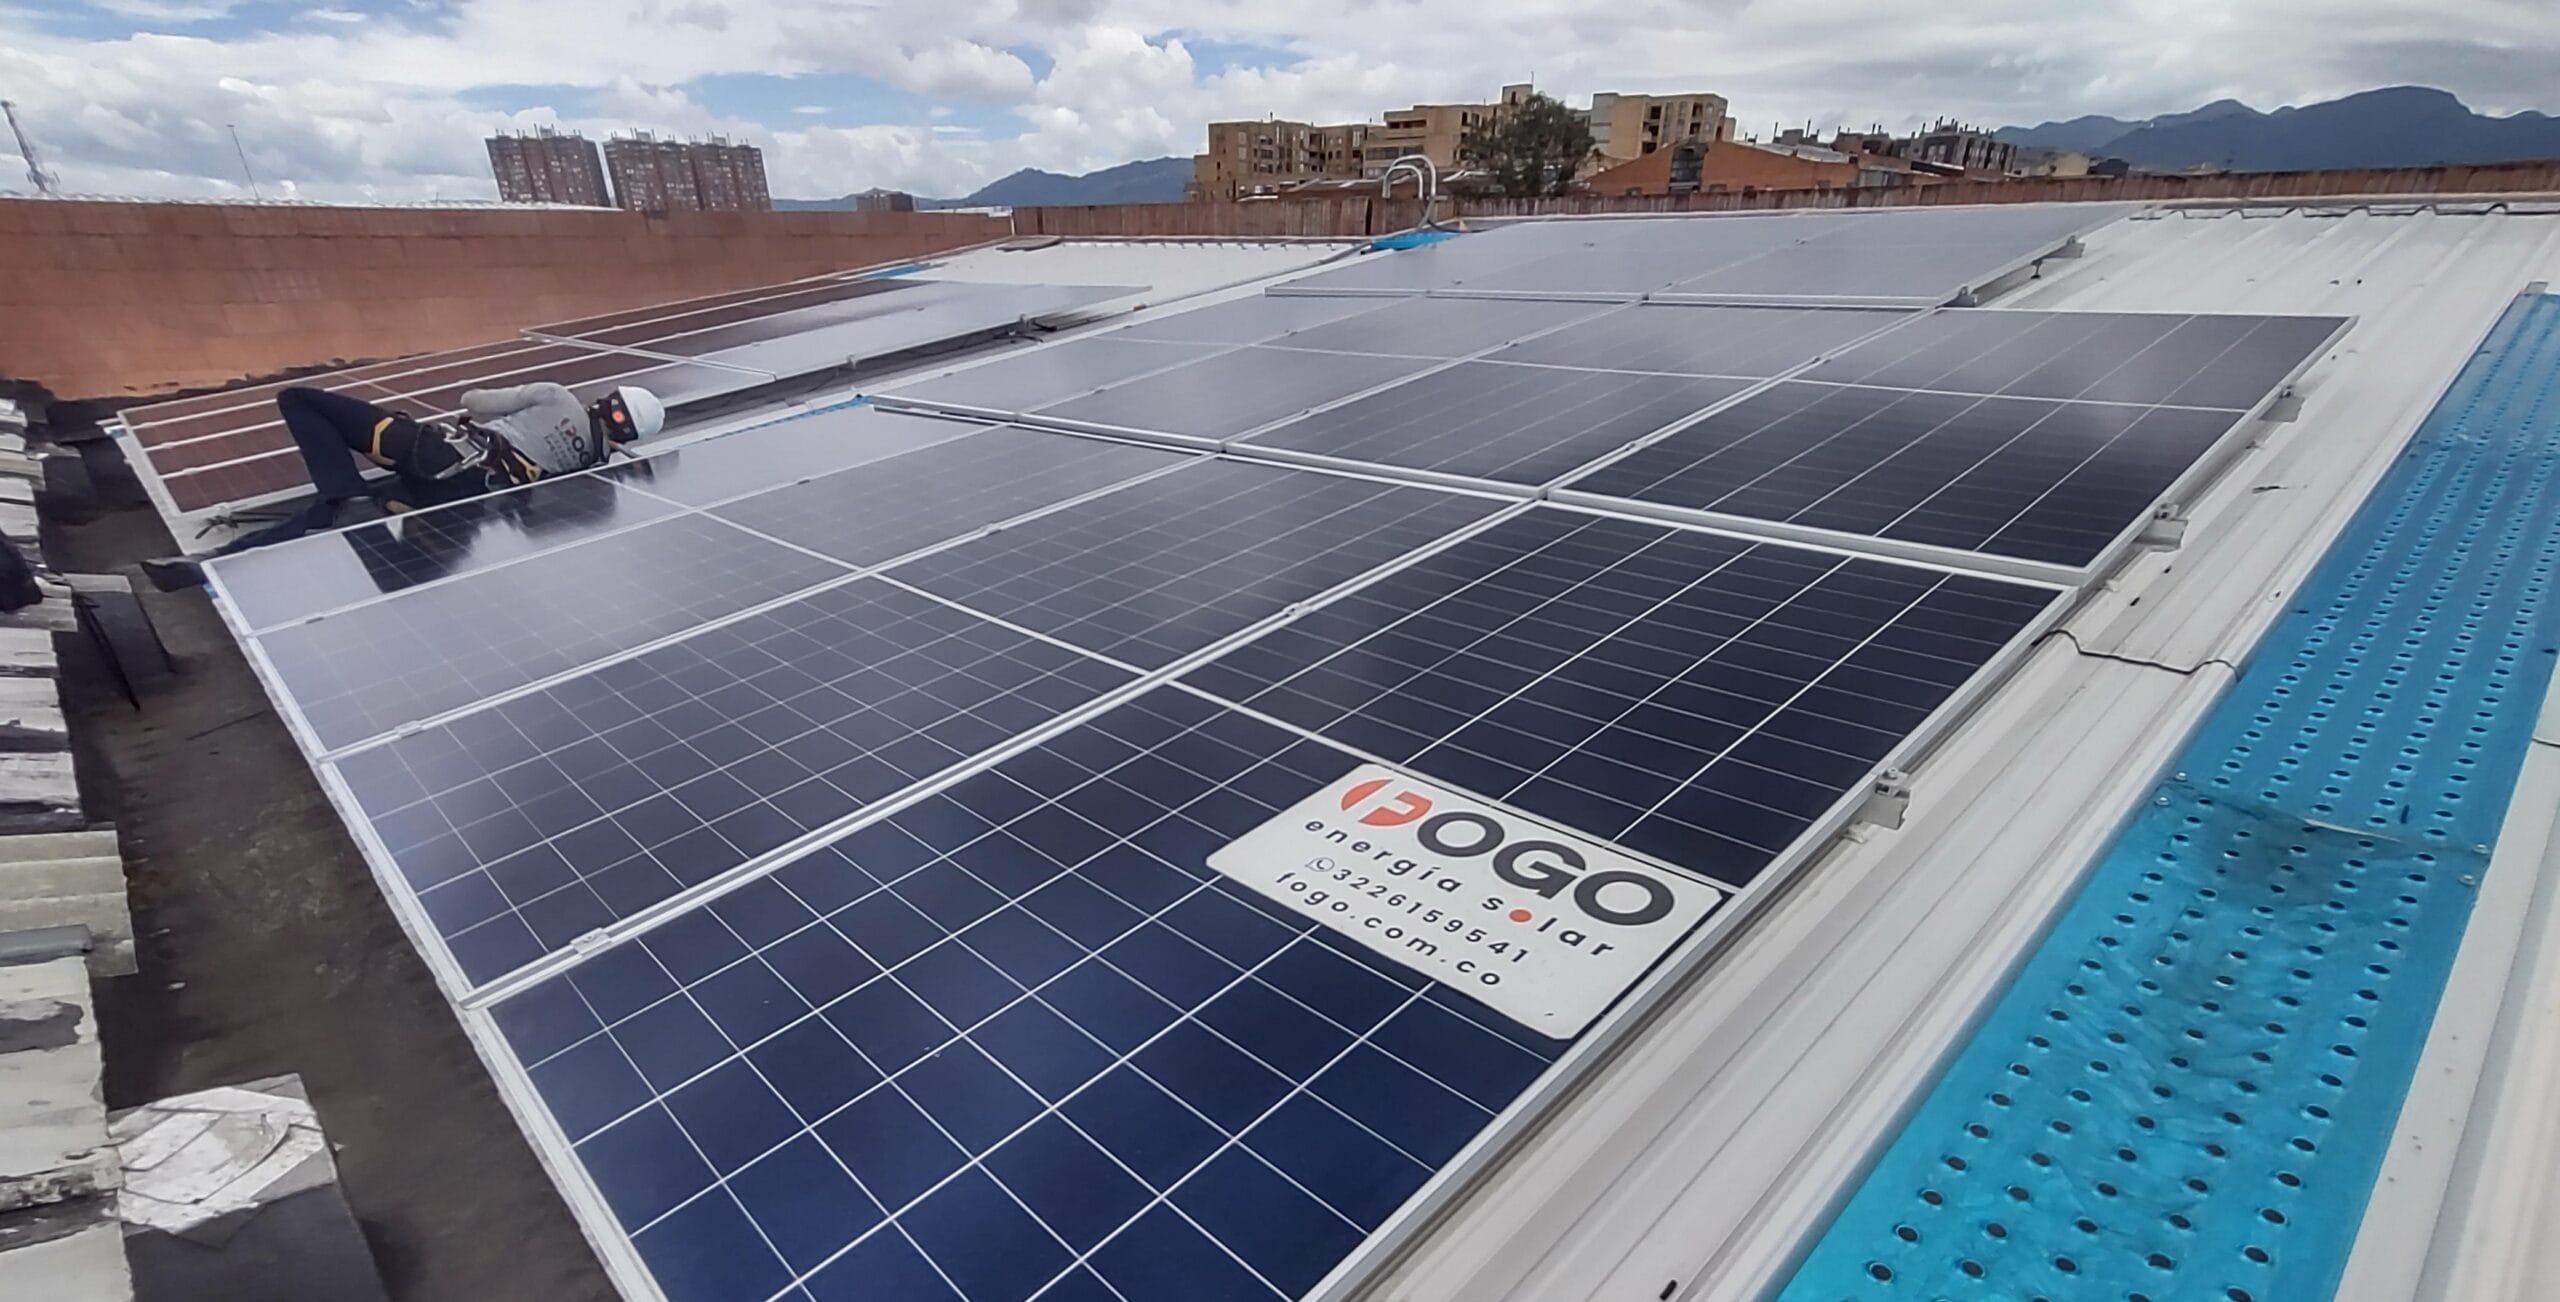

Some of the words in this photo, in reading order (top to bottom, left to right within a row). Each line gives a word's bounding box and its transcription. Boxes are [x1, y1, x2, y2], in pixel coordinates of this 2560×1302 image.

[1305, 819, 1462, 892] energía
[1481, 897, 1615, 957] solar
[1341, 779, 1674, 925] FOGO
[1276, 872, 1501, 986] fogo.com.co
[1333, 868, 1530, 964] 3226159541
